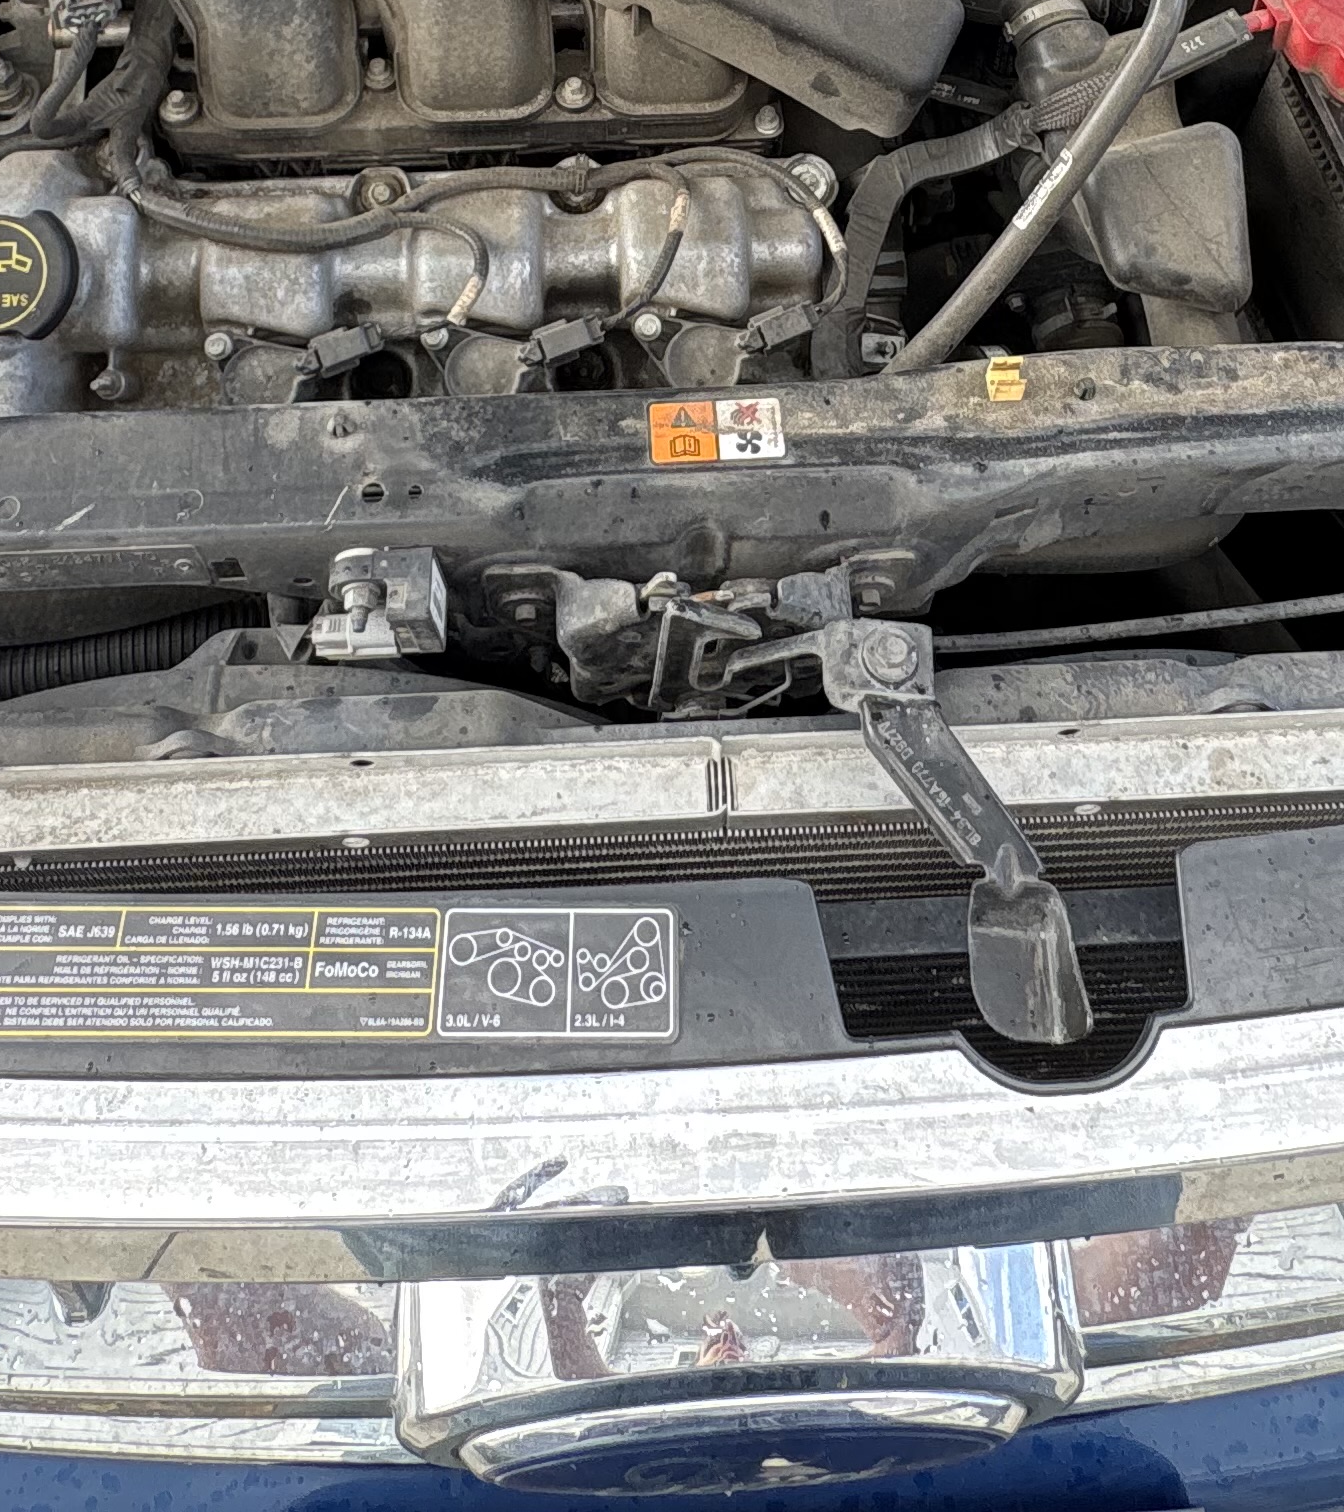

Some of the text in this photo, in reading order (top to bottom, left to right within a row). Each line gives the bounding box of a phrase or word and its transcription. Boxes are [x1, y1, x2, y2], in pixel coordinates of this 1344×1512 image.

[1, 293, 30, 308] SAE
[148, 915, 183, 925] CHARGE
[57, 924, 116, 938] SAE J639
[216, 922, 309, 939] 1.56 lb (0.71 kg)
[389, 926, 432, 939] R-134A
[124, 935, 155, 944] CARGA
[155, 935, 167, 944] DE
[55, 954, 116, 964] REFRIGERANT
[116, 955, 131, 964] OIL
[210, 956, 303, 969] WSH-M1C231-B
[79, 965, 92, 974] DE
[314, 961, 379, 978] FoMoCo
[211, 970, 221, 983] 5
[222, 970, 231, 983] fl
[232, 972, 248, 983] oz
[249, 969, 277, 985] (148
[14, 996, 26, 1006] TO
[26, 996, 39, 1006] BE
[40, 996, 83, 1006] SERVICED
[84, 996, 96, 1006] BY
[96, 996, 142, 1006] QUALIFIED
[3, 1017, 40, 1026] SISTEMA
[66, 1017, 84, 1026] SER
[154, 1017, 174, 1027] POR
[174, 1017, 219, 1027] PERSONAL
[445, 1013, 472, 1027] 3.0L
[481, 1013, 502, 1027] V-6
[574, 1013, 601, 1027] 2.3L
[609, 1013, 626, 1028] I-4
